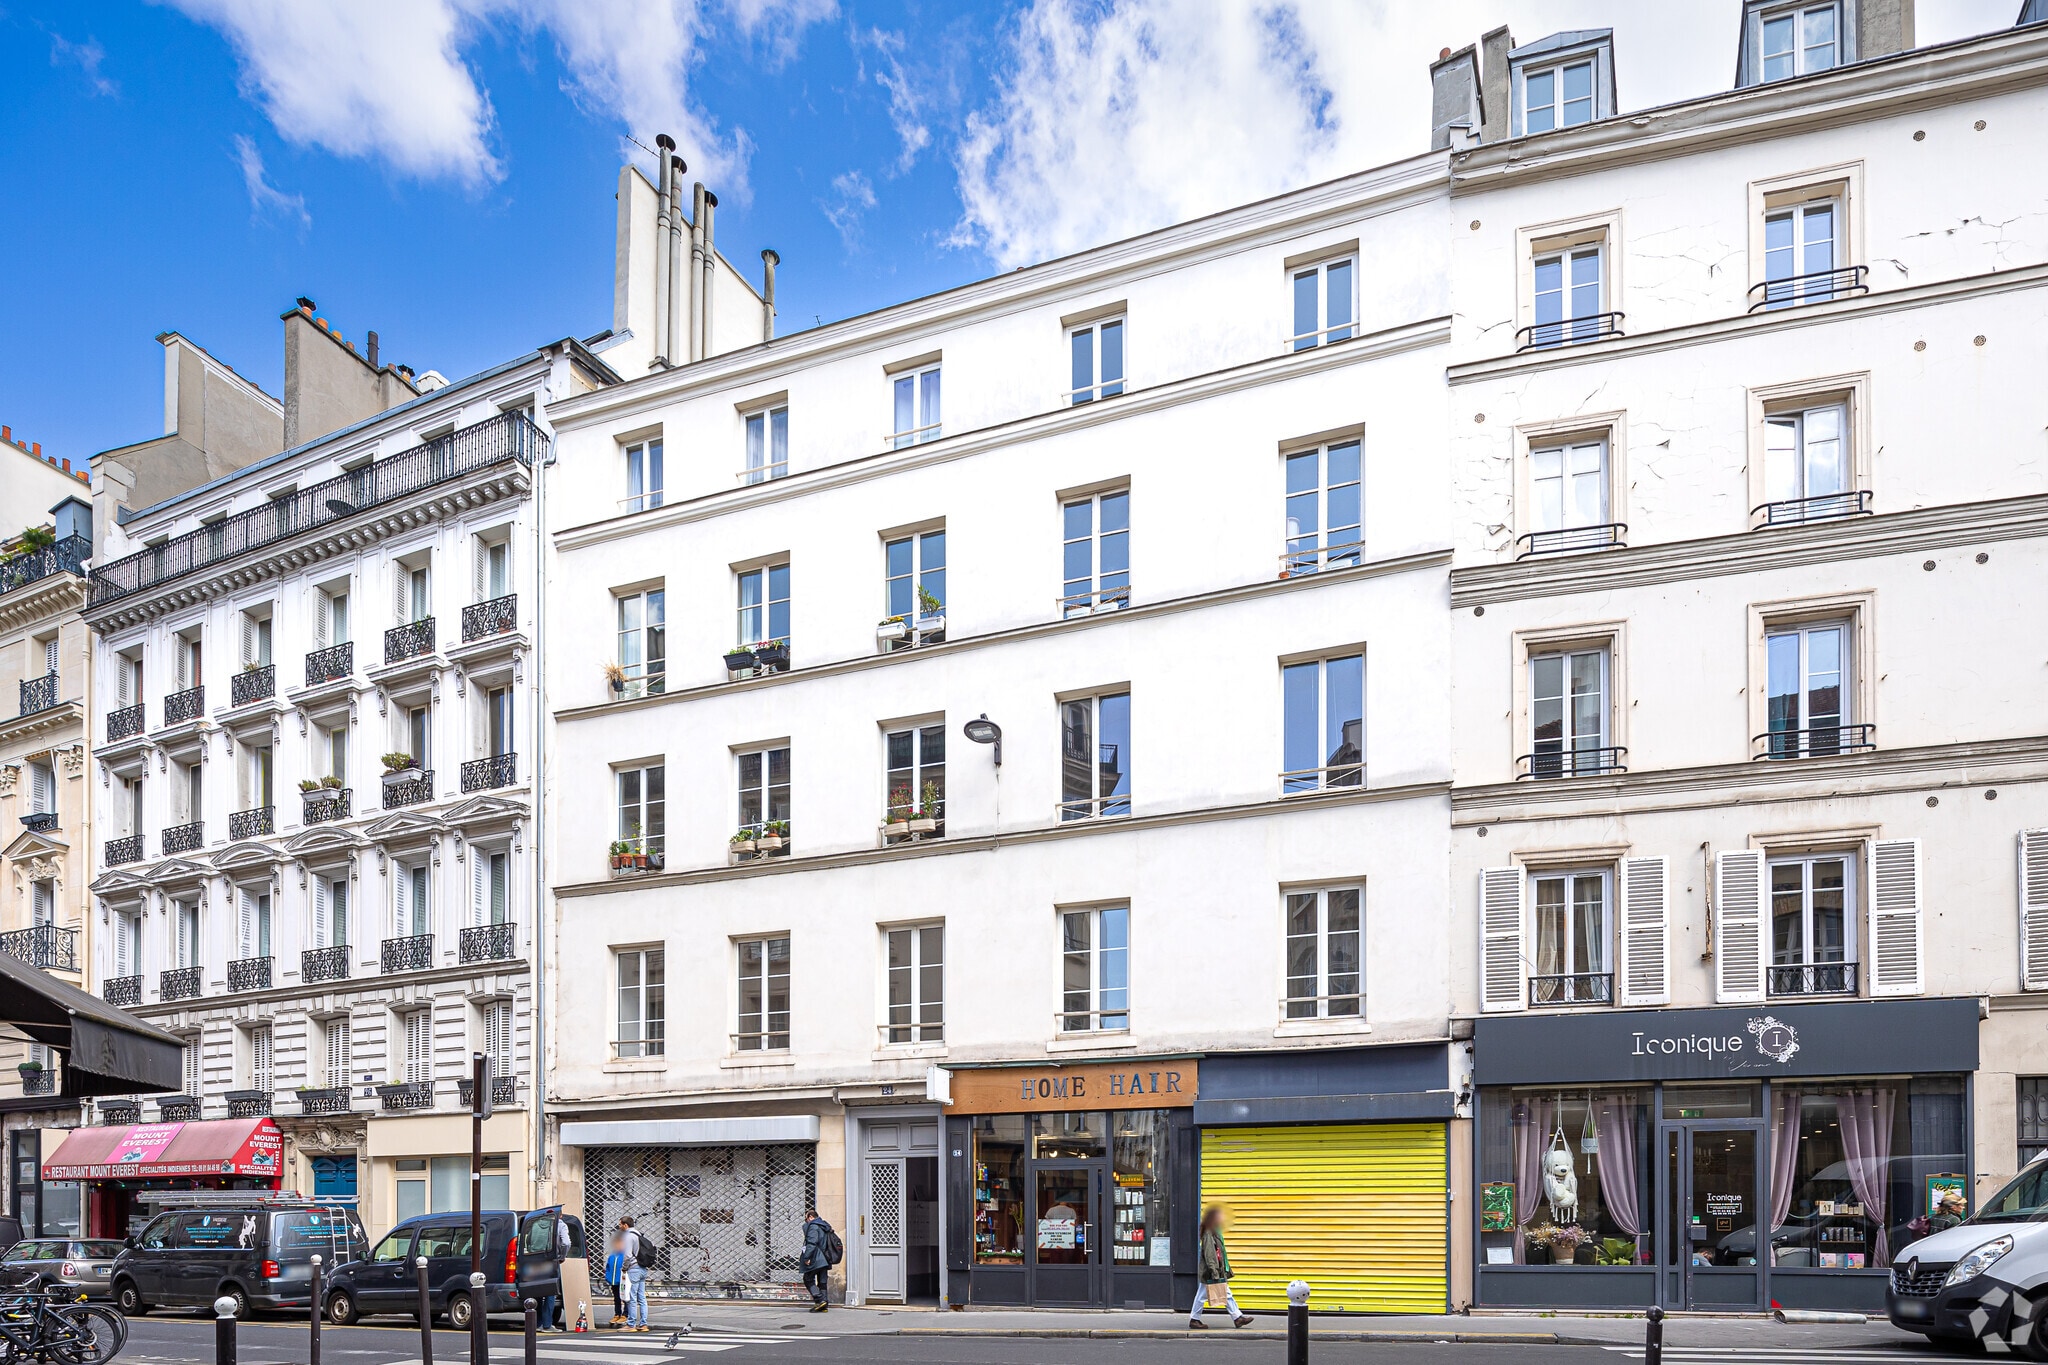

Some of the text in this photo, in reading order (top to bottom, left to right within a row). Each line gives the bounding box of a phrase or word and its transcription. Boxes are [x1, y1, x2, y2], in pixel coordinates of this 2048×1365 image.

[1631, 1032, 1743, 1061] Iconique
[1021, 1071, 1182, 1100] HOME HAIR
[131, 1131, 171, 1140] MOUNT
[253, 1134, 281, 1143] MOUNT
[121, 1138, 170, 1147] EVEREST
[249, 1140, 282, 1149] EVEREST
[51, 1165, 89, 1178] RESTAURANT
[90, 1165, 111, 1177] MOUNT
[112, 1164, 139, 1176] EVEREST
[1706, 1193, 1742, 1203] Iconique
